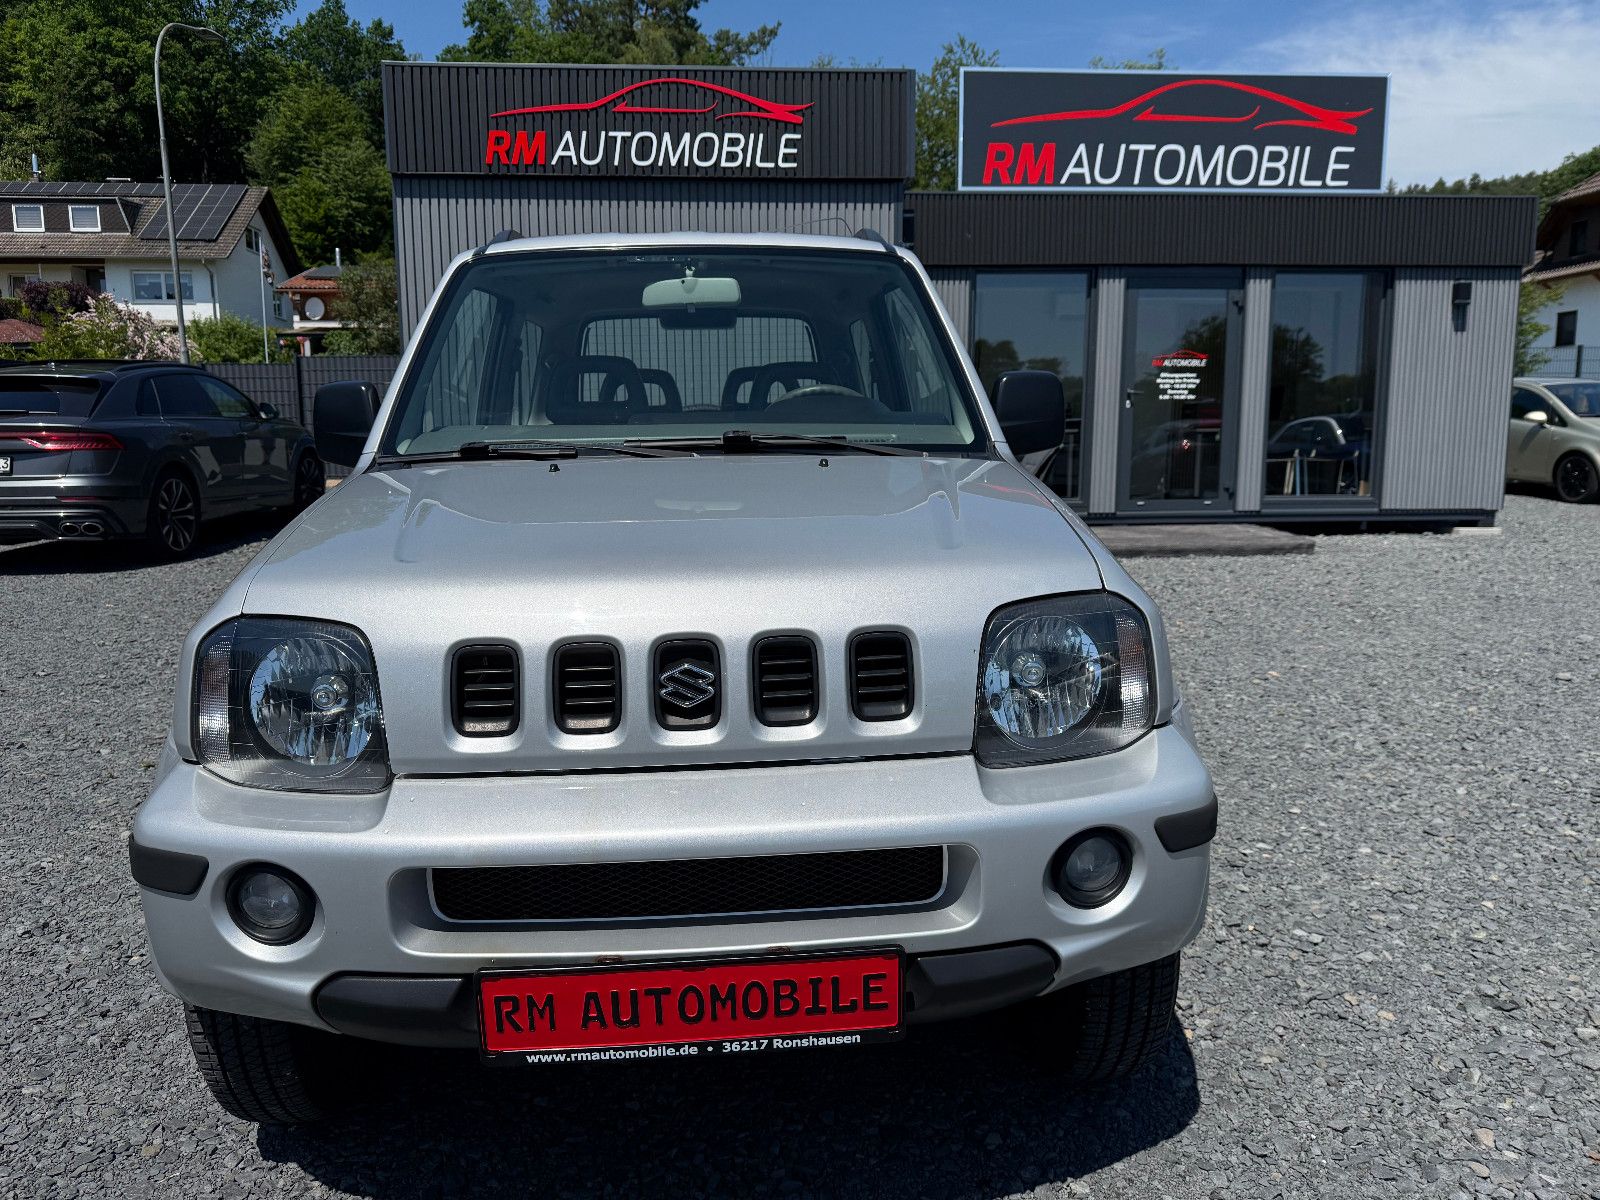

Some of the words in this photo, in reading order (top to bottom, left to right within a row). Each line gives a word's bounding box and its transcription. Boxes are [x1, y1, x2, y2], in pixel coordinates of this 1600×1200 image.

[485, 130, 548, 165] RM
[551, 130, 802, 169] AUTOMOBILE
[982, 142, 1057, 186] RM
[1059, 144, 1356, 187] AUTOMOBILE
[493, 993, 556, 1033] RM
[581, 972, 890, 1029] AUTOMOBILE
[526, 1044, 699, 1064] www.rmautomobile.de
[721, 1039, 769, 1054] 36217
[772, 1032, 862, 1050] Ronshausen
